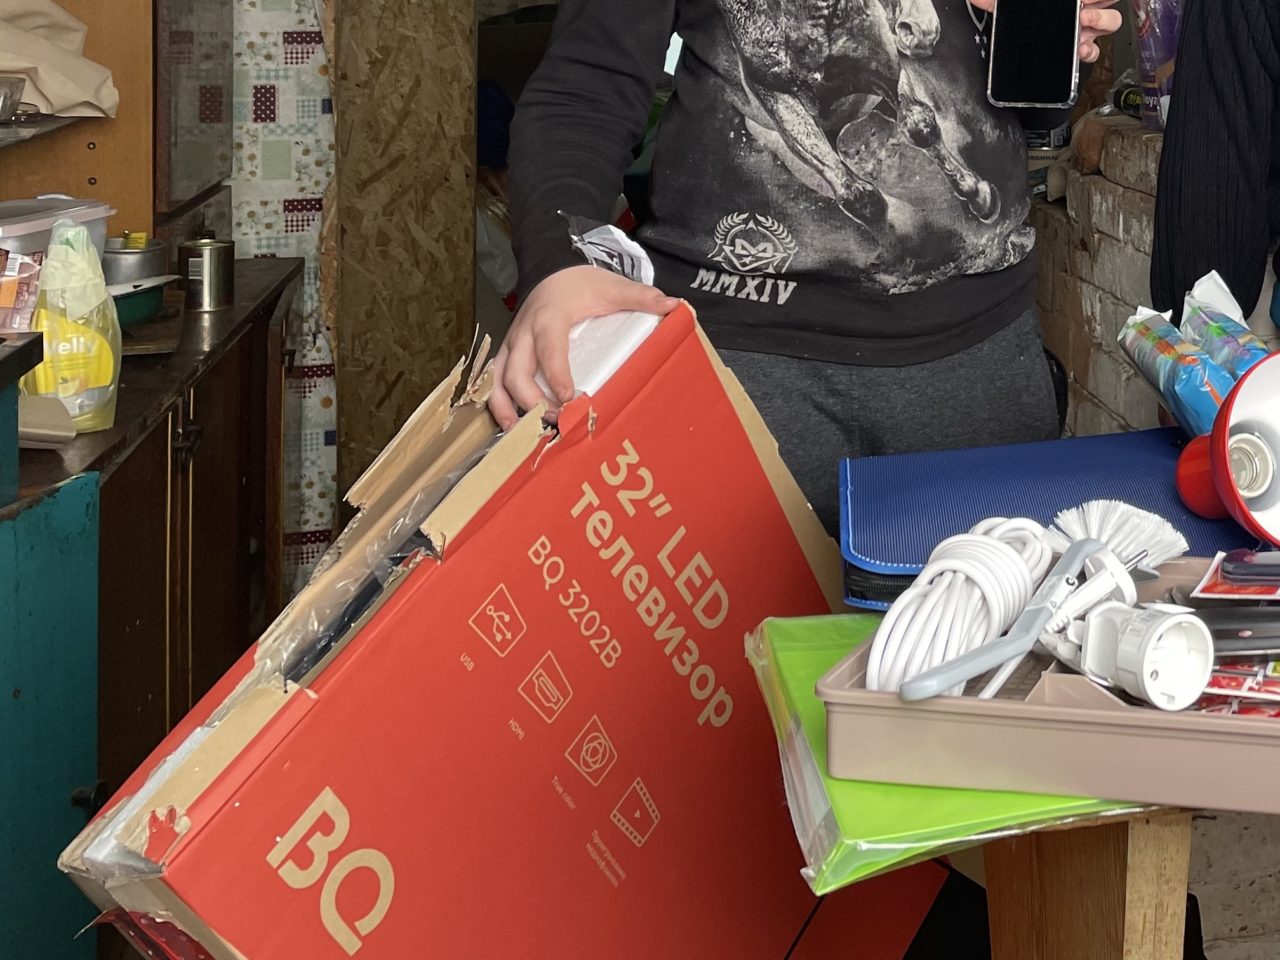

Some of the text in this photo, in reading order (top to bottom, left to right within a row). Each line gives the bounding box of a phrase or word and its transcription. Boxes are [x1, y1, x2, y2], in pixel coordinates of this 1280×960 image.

[690, 268, 797, 305] MMXIV
[601, 439, 729, 629] 32" LED
[460, 652, 475, 671] USB
[528, 535, 622, 669] BQ 3202B
[570, 481, 734, 728] телевизор
[508, 717, 525, 740] HDMI
[266, 786, 395, 957] BQ
